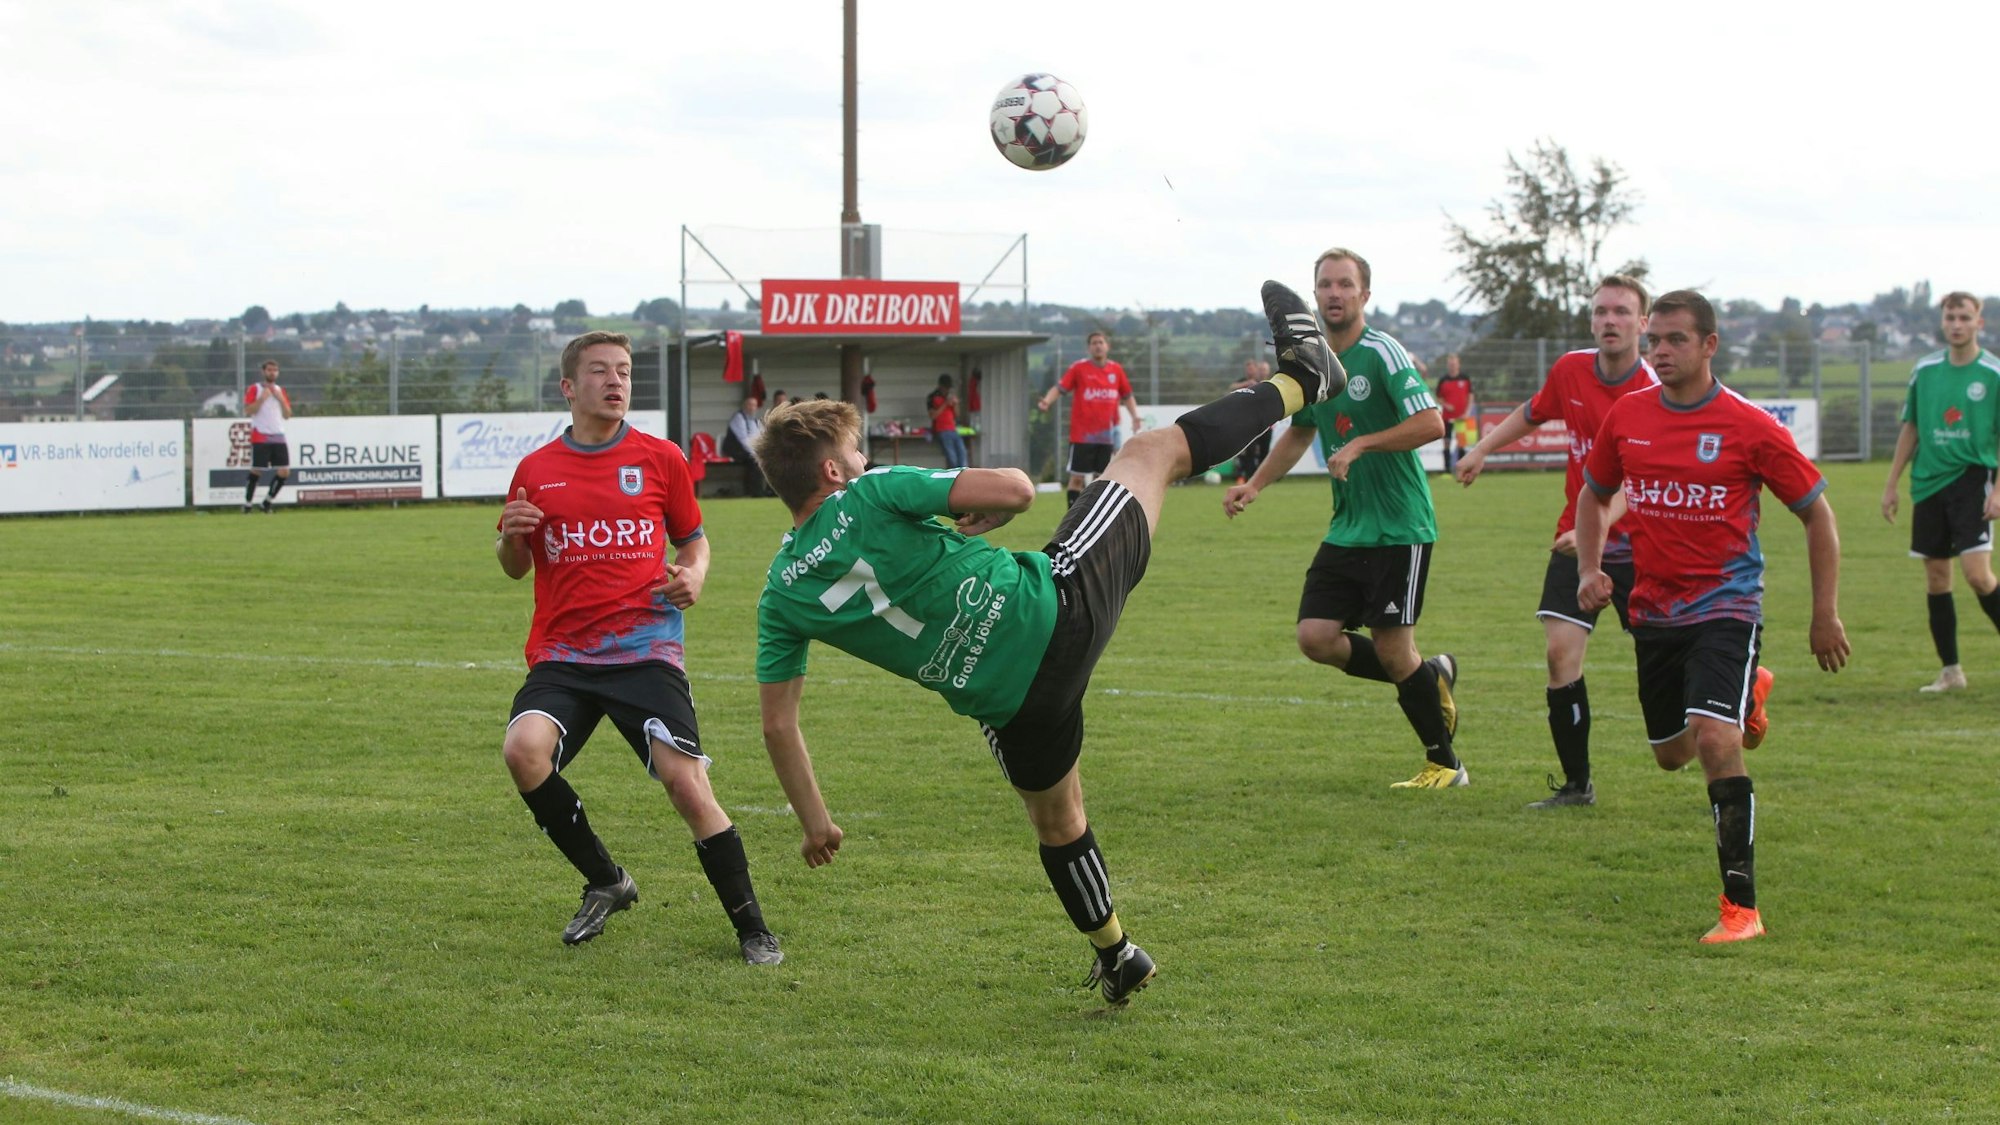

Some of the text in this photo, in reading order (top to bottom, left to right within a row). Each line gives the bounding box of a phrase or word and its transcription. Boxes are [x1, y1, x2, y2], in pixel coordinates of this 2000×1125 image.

[769, 293, 954, 326] DJK DREIBORN
[21, 441, 178, 460] VR-Bank Nordeifel eG
[832, 510, 854, 541] e.V.
[1641, 509, 1727, 522] RUND UM EDELSTAHL
[562, 519, 655, 549] HÖRR
[564, 551, 655, 563] RUND UM EDELSTAHL
[818, 556, 926, 640] 7
[974, 593, 1006, 644] Jöbges
[970, 644, 984, 655] &
[952, 656, 978, 689] Groß
